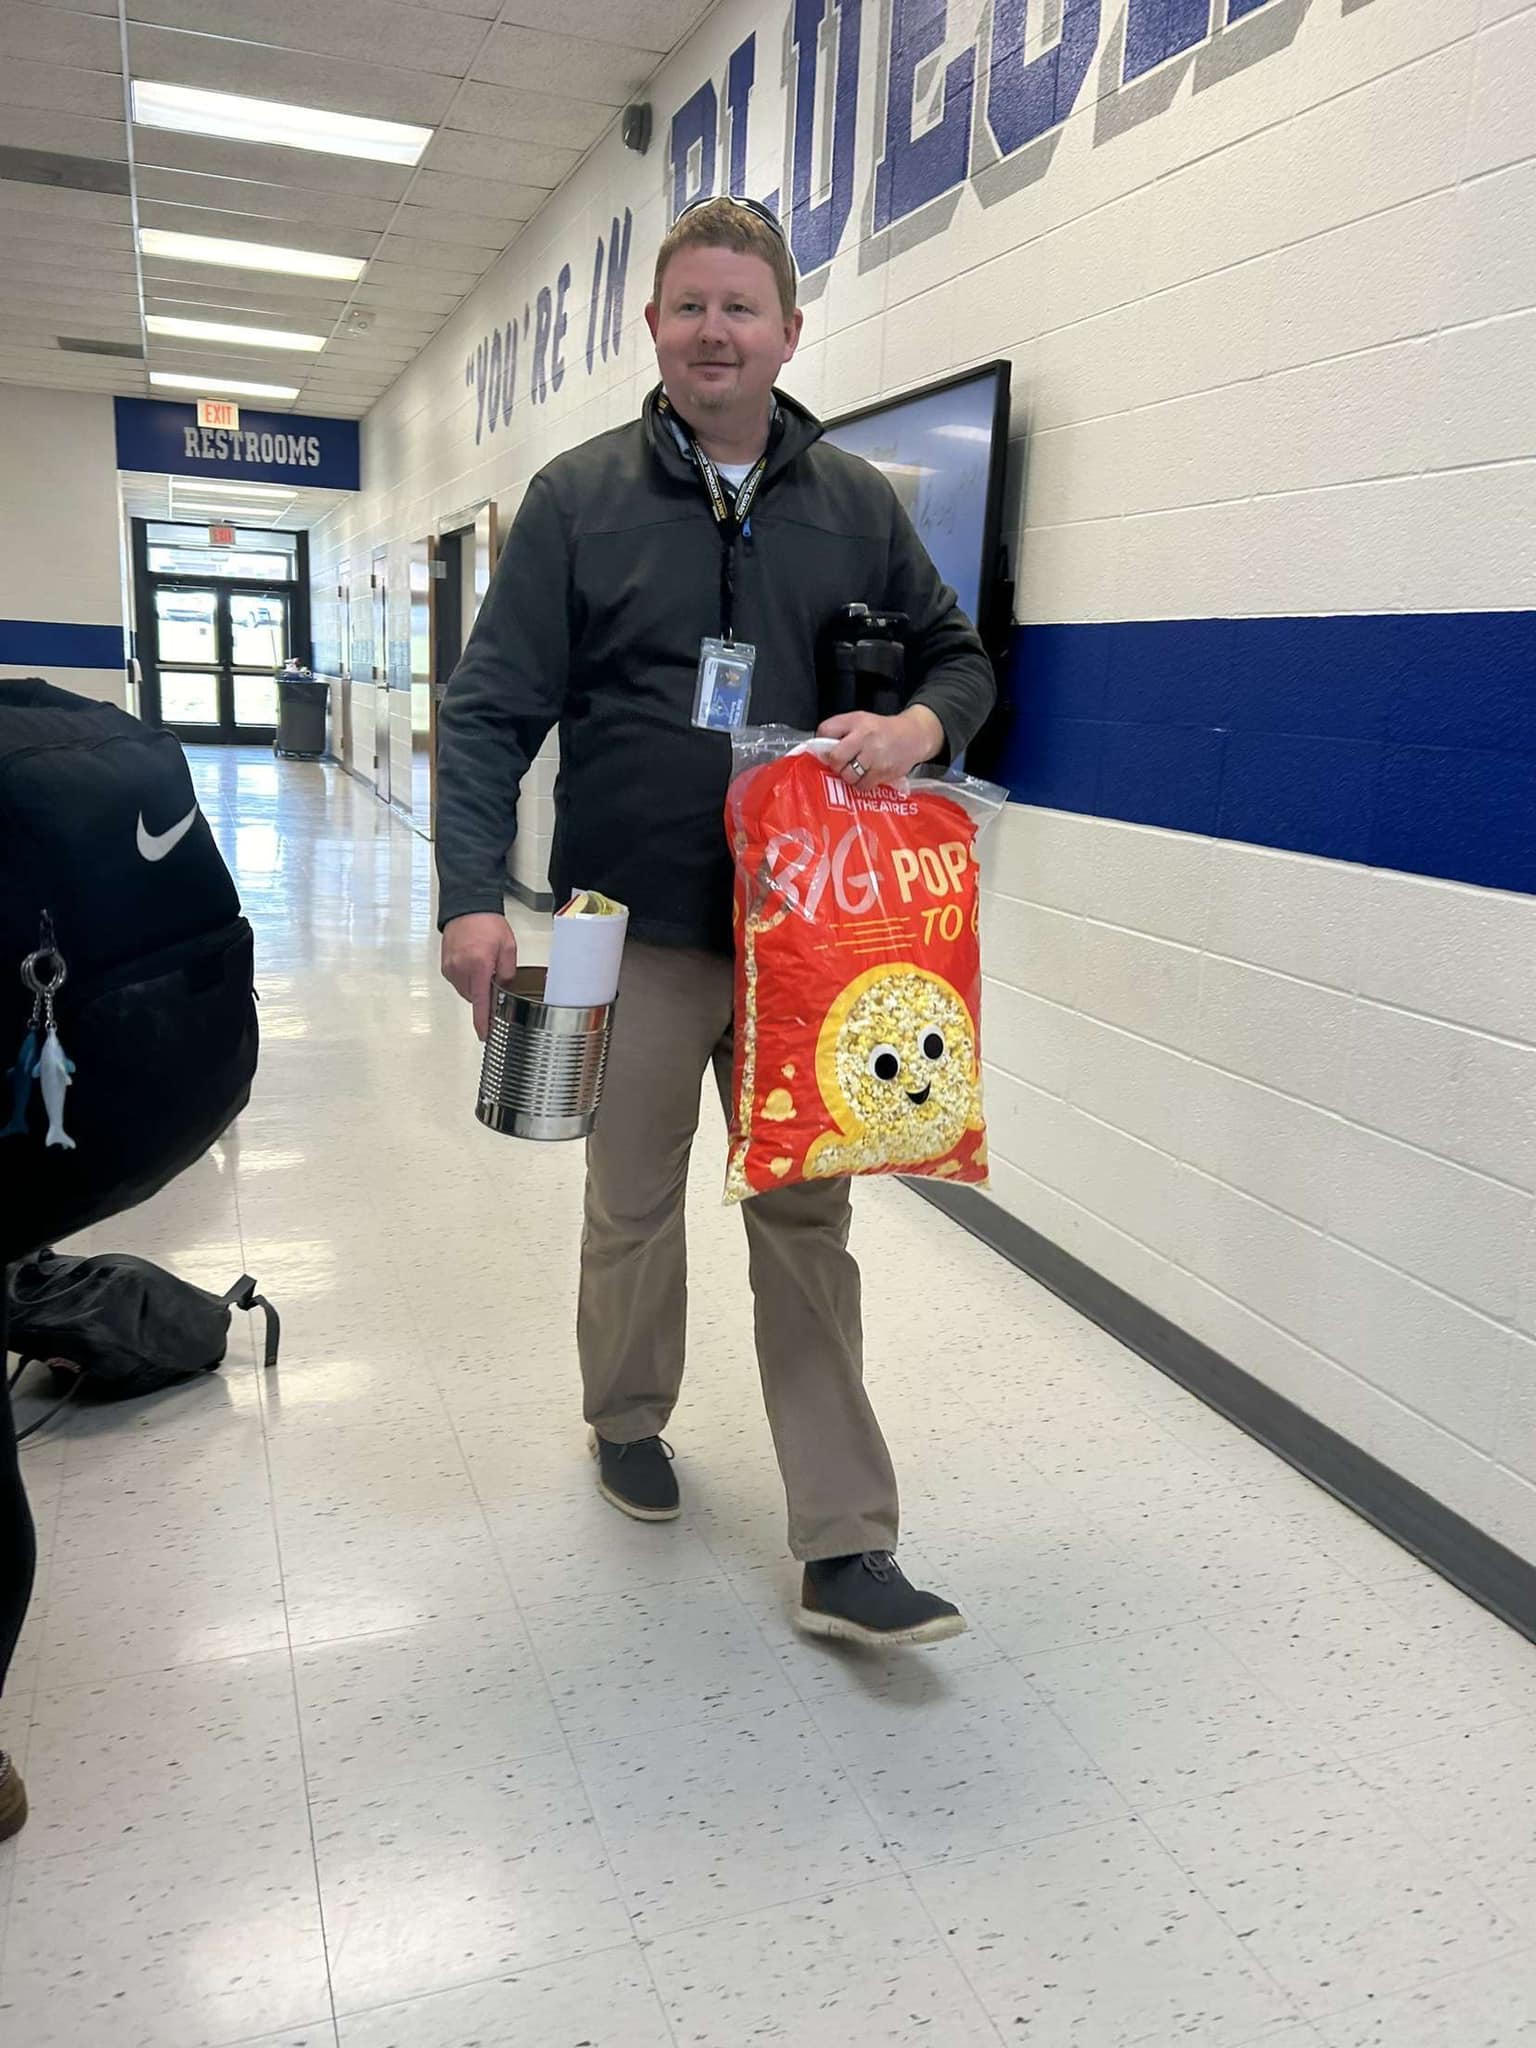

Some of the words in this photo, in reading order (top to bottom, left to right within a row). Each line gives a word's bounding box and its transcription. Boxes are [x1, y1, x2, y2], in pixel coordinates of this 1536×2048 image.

[586, 206, 633, 376] IN
[204, 404, 233, 426] EXIT
[183, 426, 321, 467] RESTROOMS
[765, 824, 884, 918] BIG
[920, 904, 964, 945] TO
